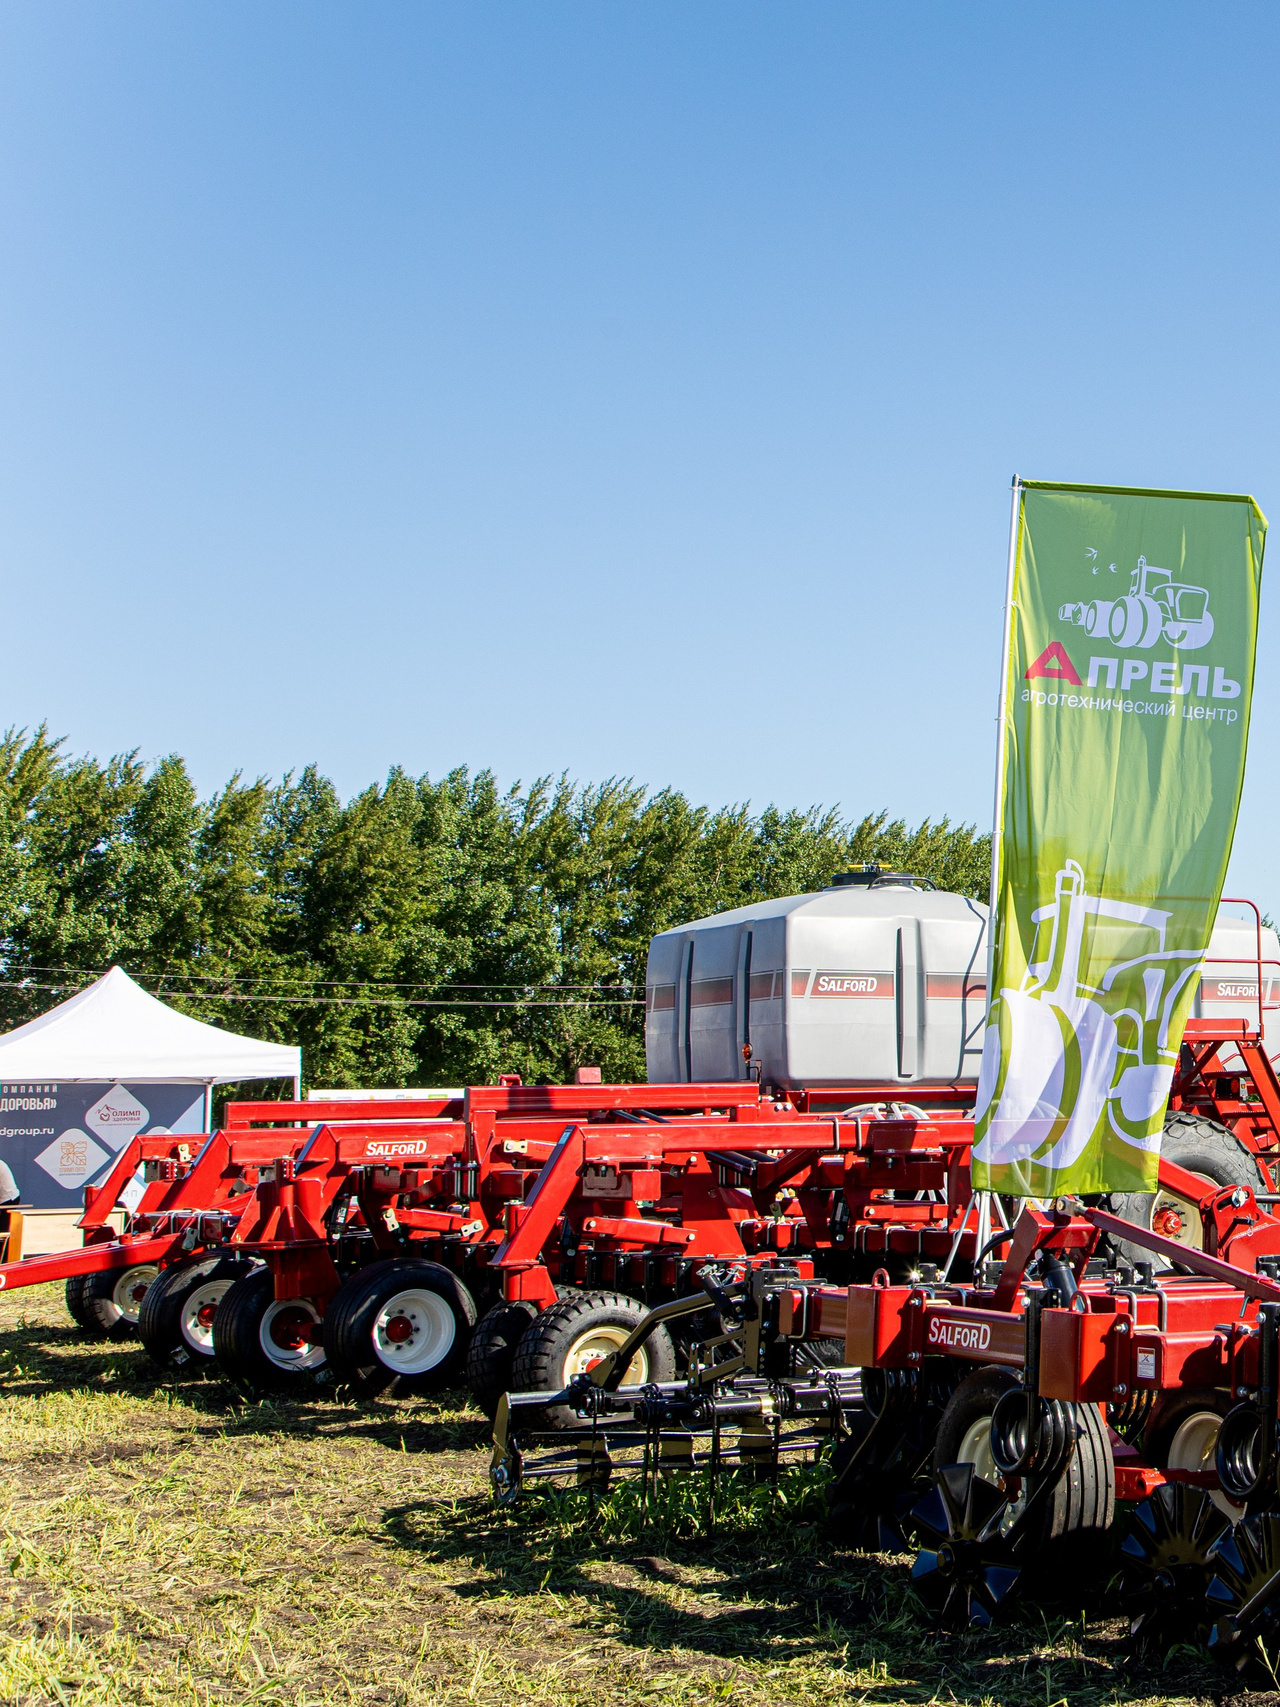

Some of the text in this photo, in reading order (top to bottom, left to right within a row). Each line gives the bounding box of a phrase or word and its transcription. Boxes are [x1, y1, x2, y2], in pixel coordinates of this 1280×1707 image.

[1021, 688, 1238, 725] агротехнический центр
[0, 1127, 55, 1138] dgroup.ru
[366, 1140, 427, 1156] SALFORD
[929, 1317, 991, 1350] SALFORD
